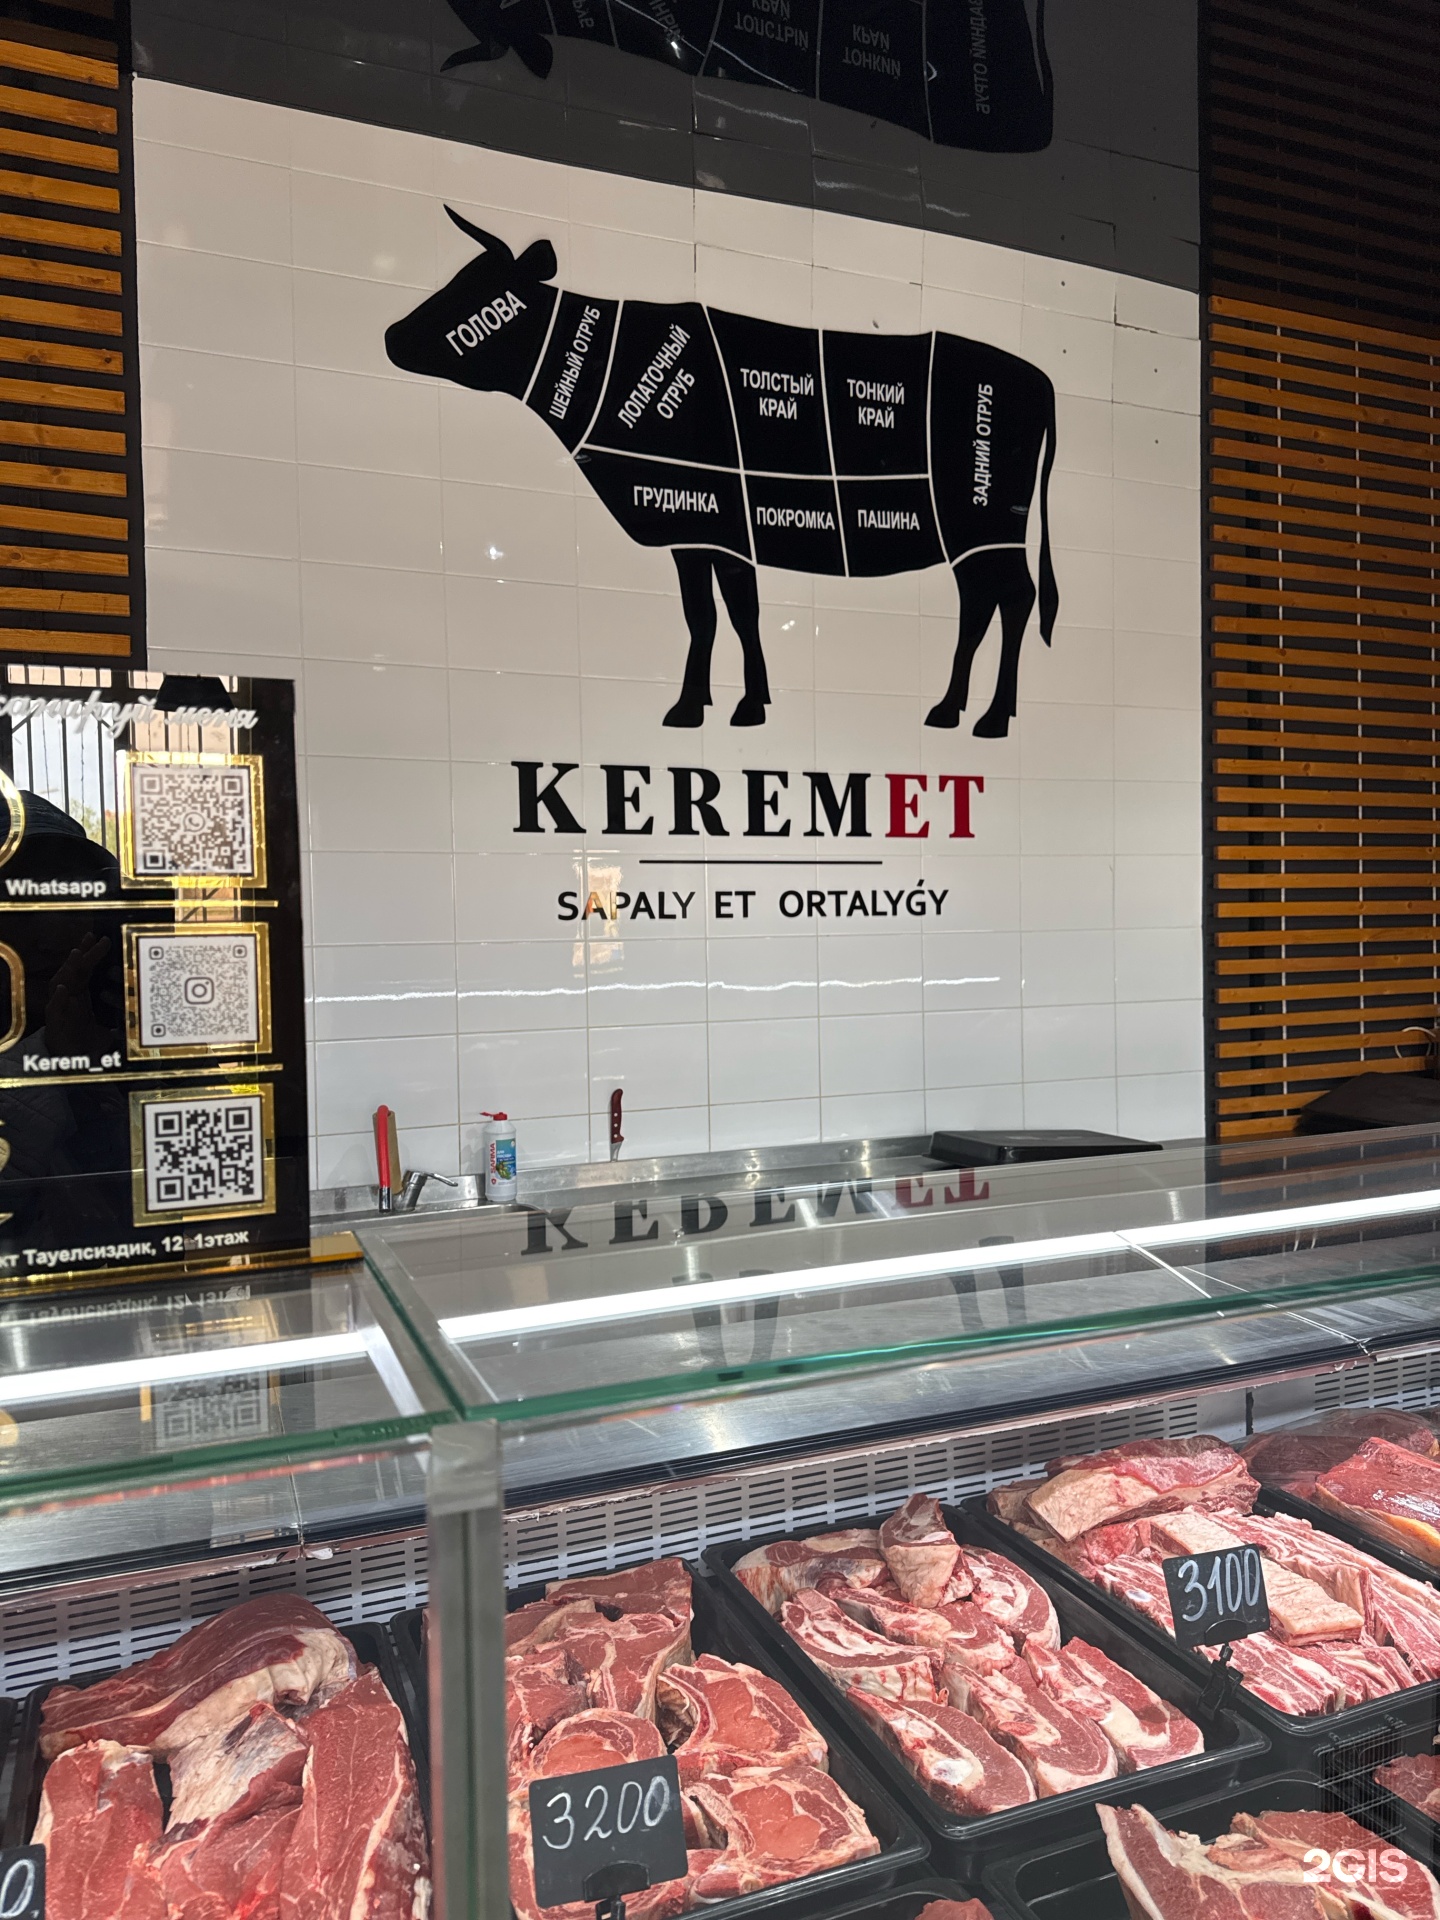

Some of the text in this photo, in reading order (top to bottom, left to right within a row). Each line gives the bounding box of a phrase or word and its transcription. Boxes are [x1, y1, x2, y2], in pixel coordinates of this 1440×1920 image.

[445, 290, 528, 357] ГОЛОВА
[549, 305, 601, 420] ШЕЙНЫЙ ОТРУБ
[617, 323, 691, 429] ЛОПАТОЧНЫЙ
[656, 368, 695, 419] ОТРУБ
[740, 368, 814, 396] ТОЛСТЫЙ
[847, 379, 905, 405] ТОНКИЙ
[759, 397, 797, 420] КРАЙ
[858, 406, 895, 429] КРАЙ
[972, 383, 993, 507] ЗАДНИЙ ОТРУБ
[633, 485, 719, 514] ГРУДИНКА
[756, 507, 836, 530] ПОКРОМКА
[857, 509, 920, 531] ПАШИНА
[511, 761, 984, 838] KEREMET
[5, 878, 107, 898] Whatsapp
[557, 890, 696, 921] SAPALY
[715, 890, 757, 919] ET
[22, 1051, 122, 1073] Kerem_et
[22, 1242, 157, 1268] Тауелсиздик,
[161, 1235, 184, 1252] 12
[194, 1231, 250, 1249] 1этаж
[1178, 1549, 1260, 1622] 3100
[542, 1775, 671, 1850] 3200
